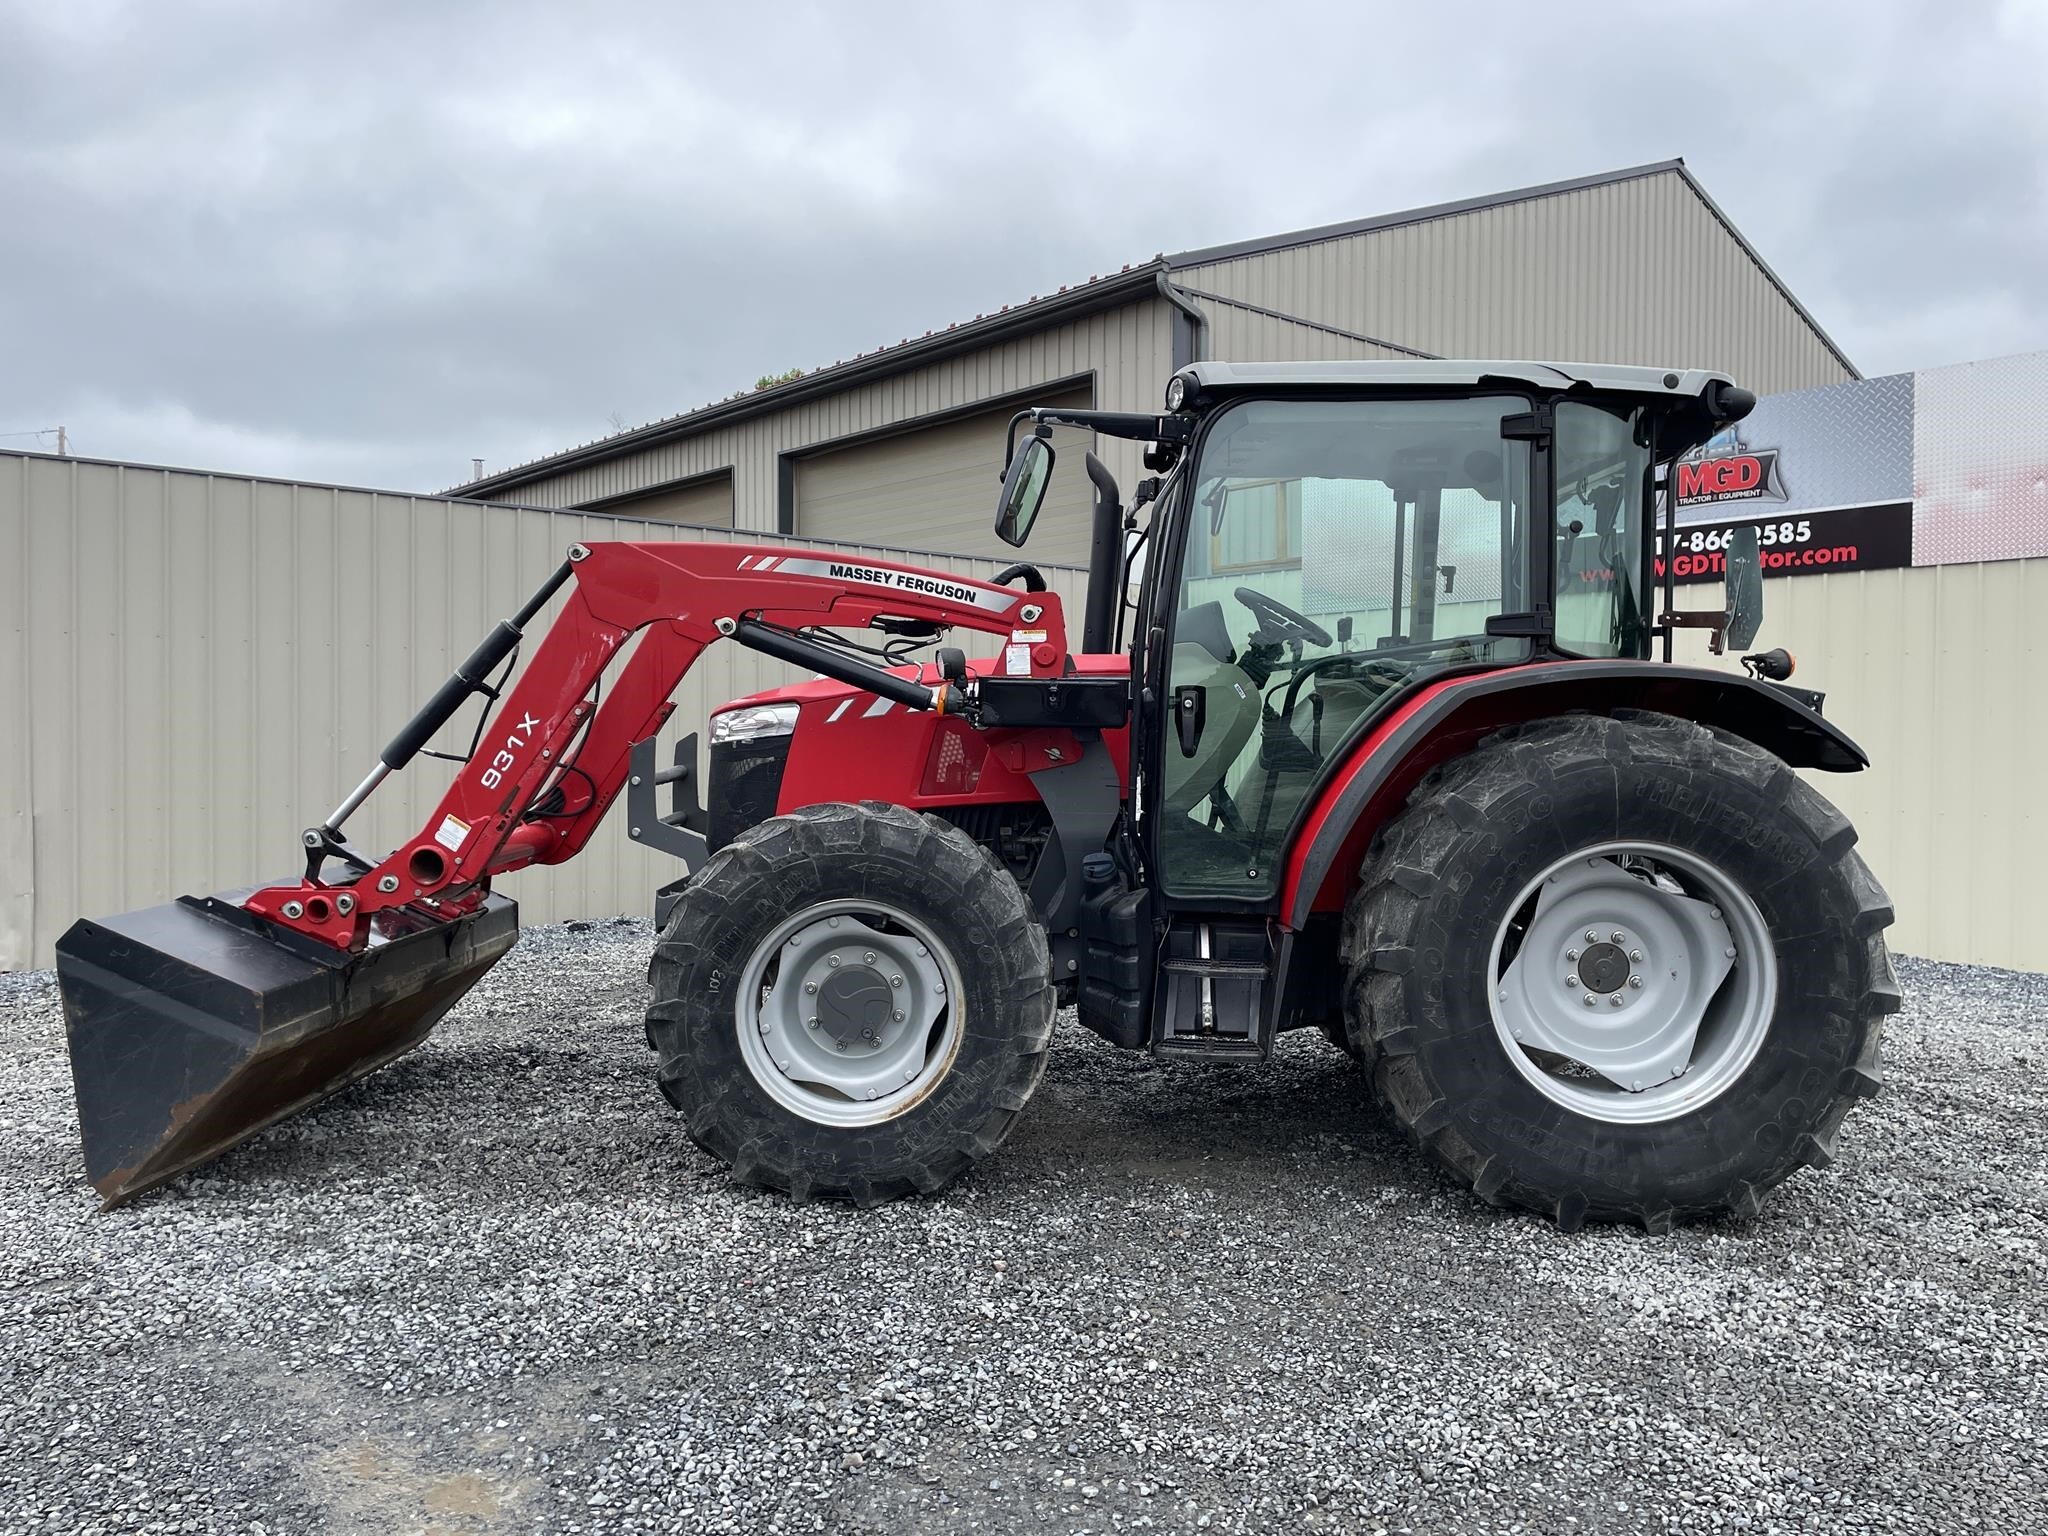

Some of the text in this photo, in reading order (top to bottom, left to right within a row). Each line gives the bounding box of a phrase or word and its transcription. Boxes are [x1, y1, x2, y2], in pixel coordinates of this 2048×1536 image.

[1679, 456, 1761, 497] MGD
[1679, 494, 1712, 505] TRACTOR
[1719, 489, 1760, 500] EQUIPMENT
[830, 564, 977, 603] MASSEY FERGUSON
